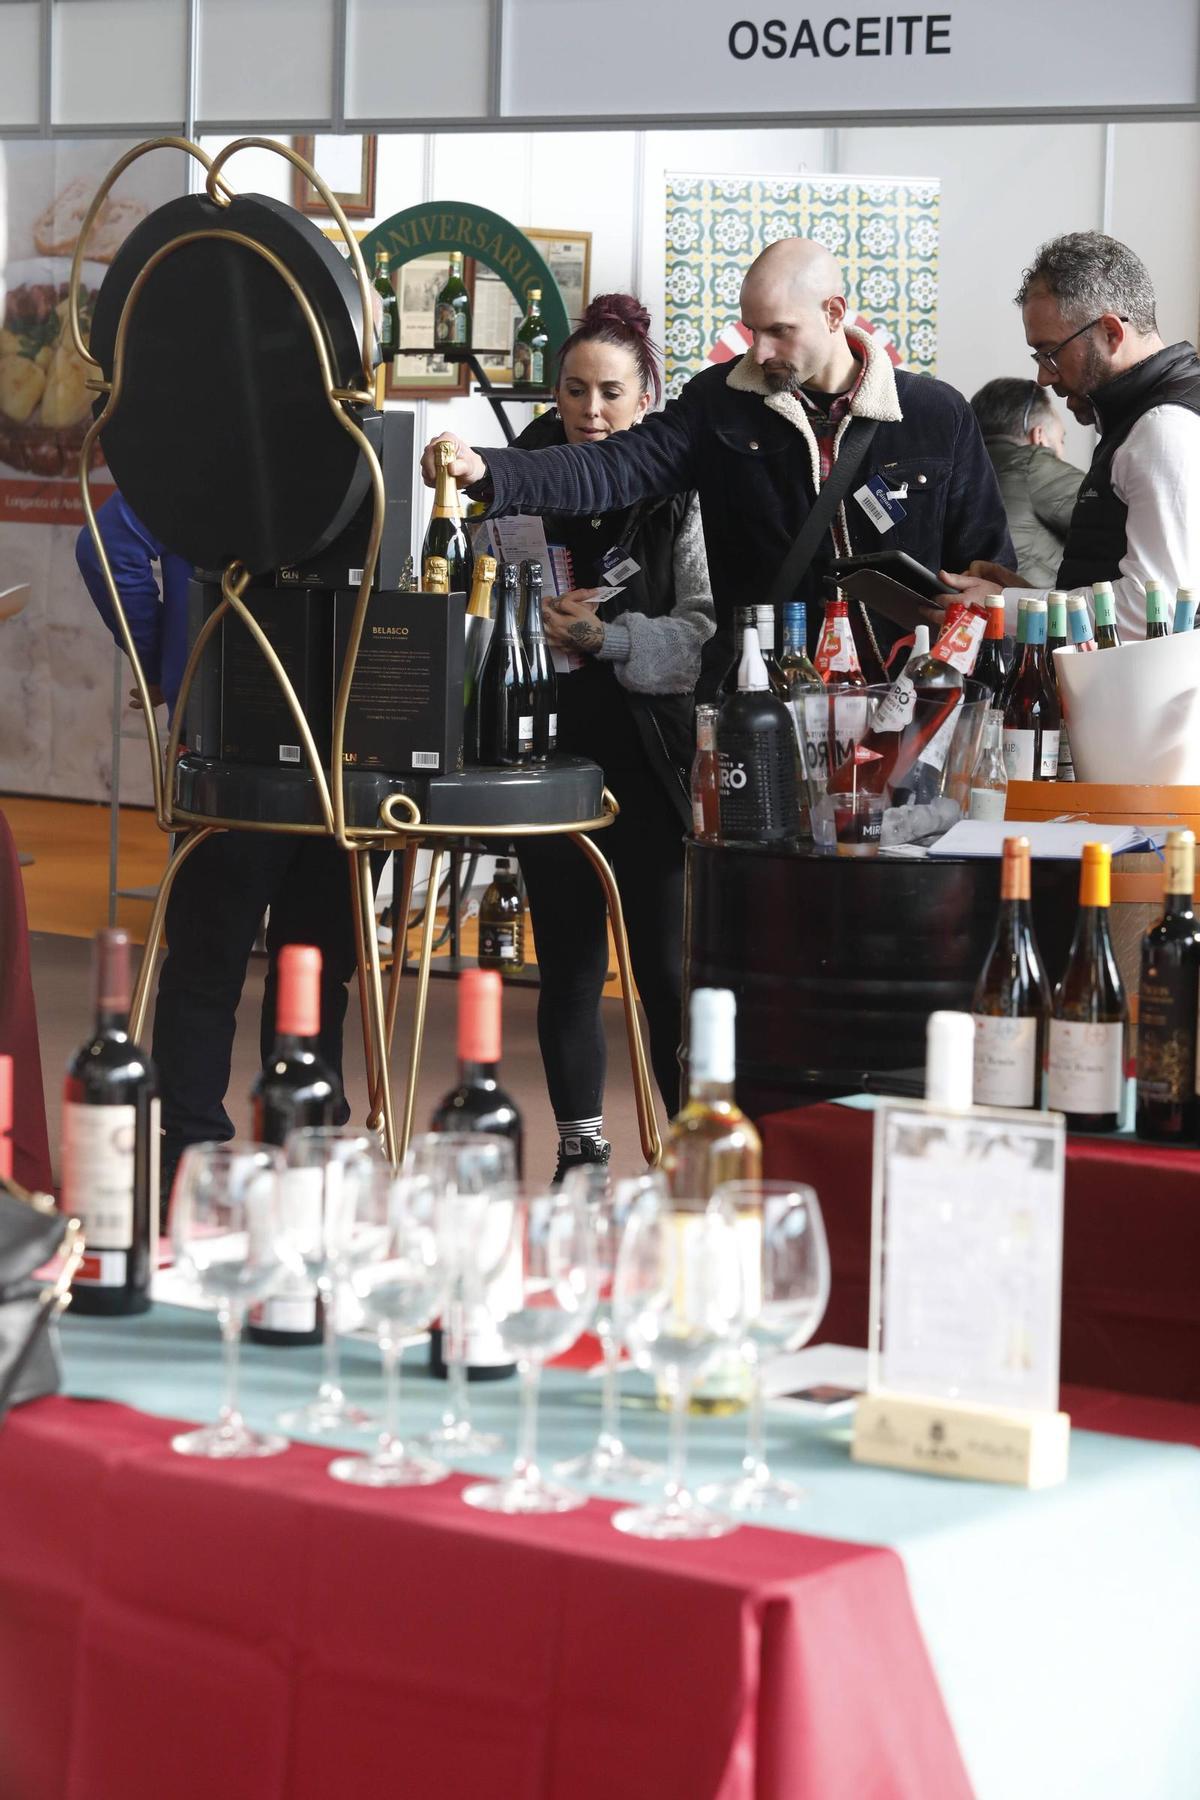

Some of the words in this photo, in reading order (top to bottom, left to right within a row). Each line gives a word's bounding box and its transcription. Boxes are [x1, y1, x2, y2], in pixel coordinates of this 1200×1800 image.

[728, 14, 952, 60] OSACEITE
[1104, 608, 1111, 617] H
[372, 626, 409, 635] BELASCO
[1051, 620, 1057, 630] H
[719, 762, 748, 789] RÓ
[862, 824, 881, 836] MIR
